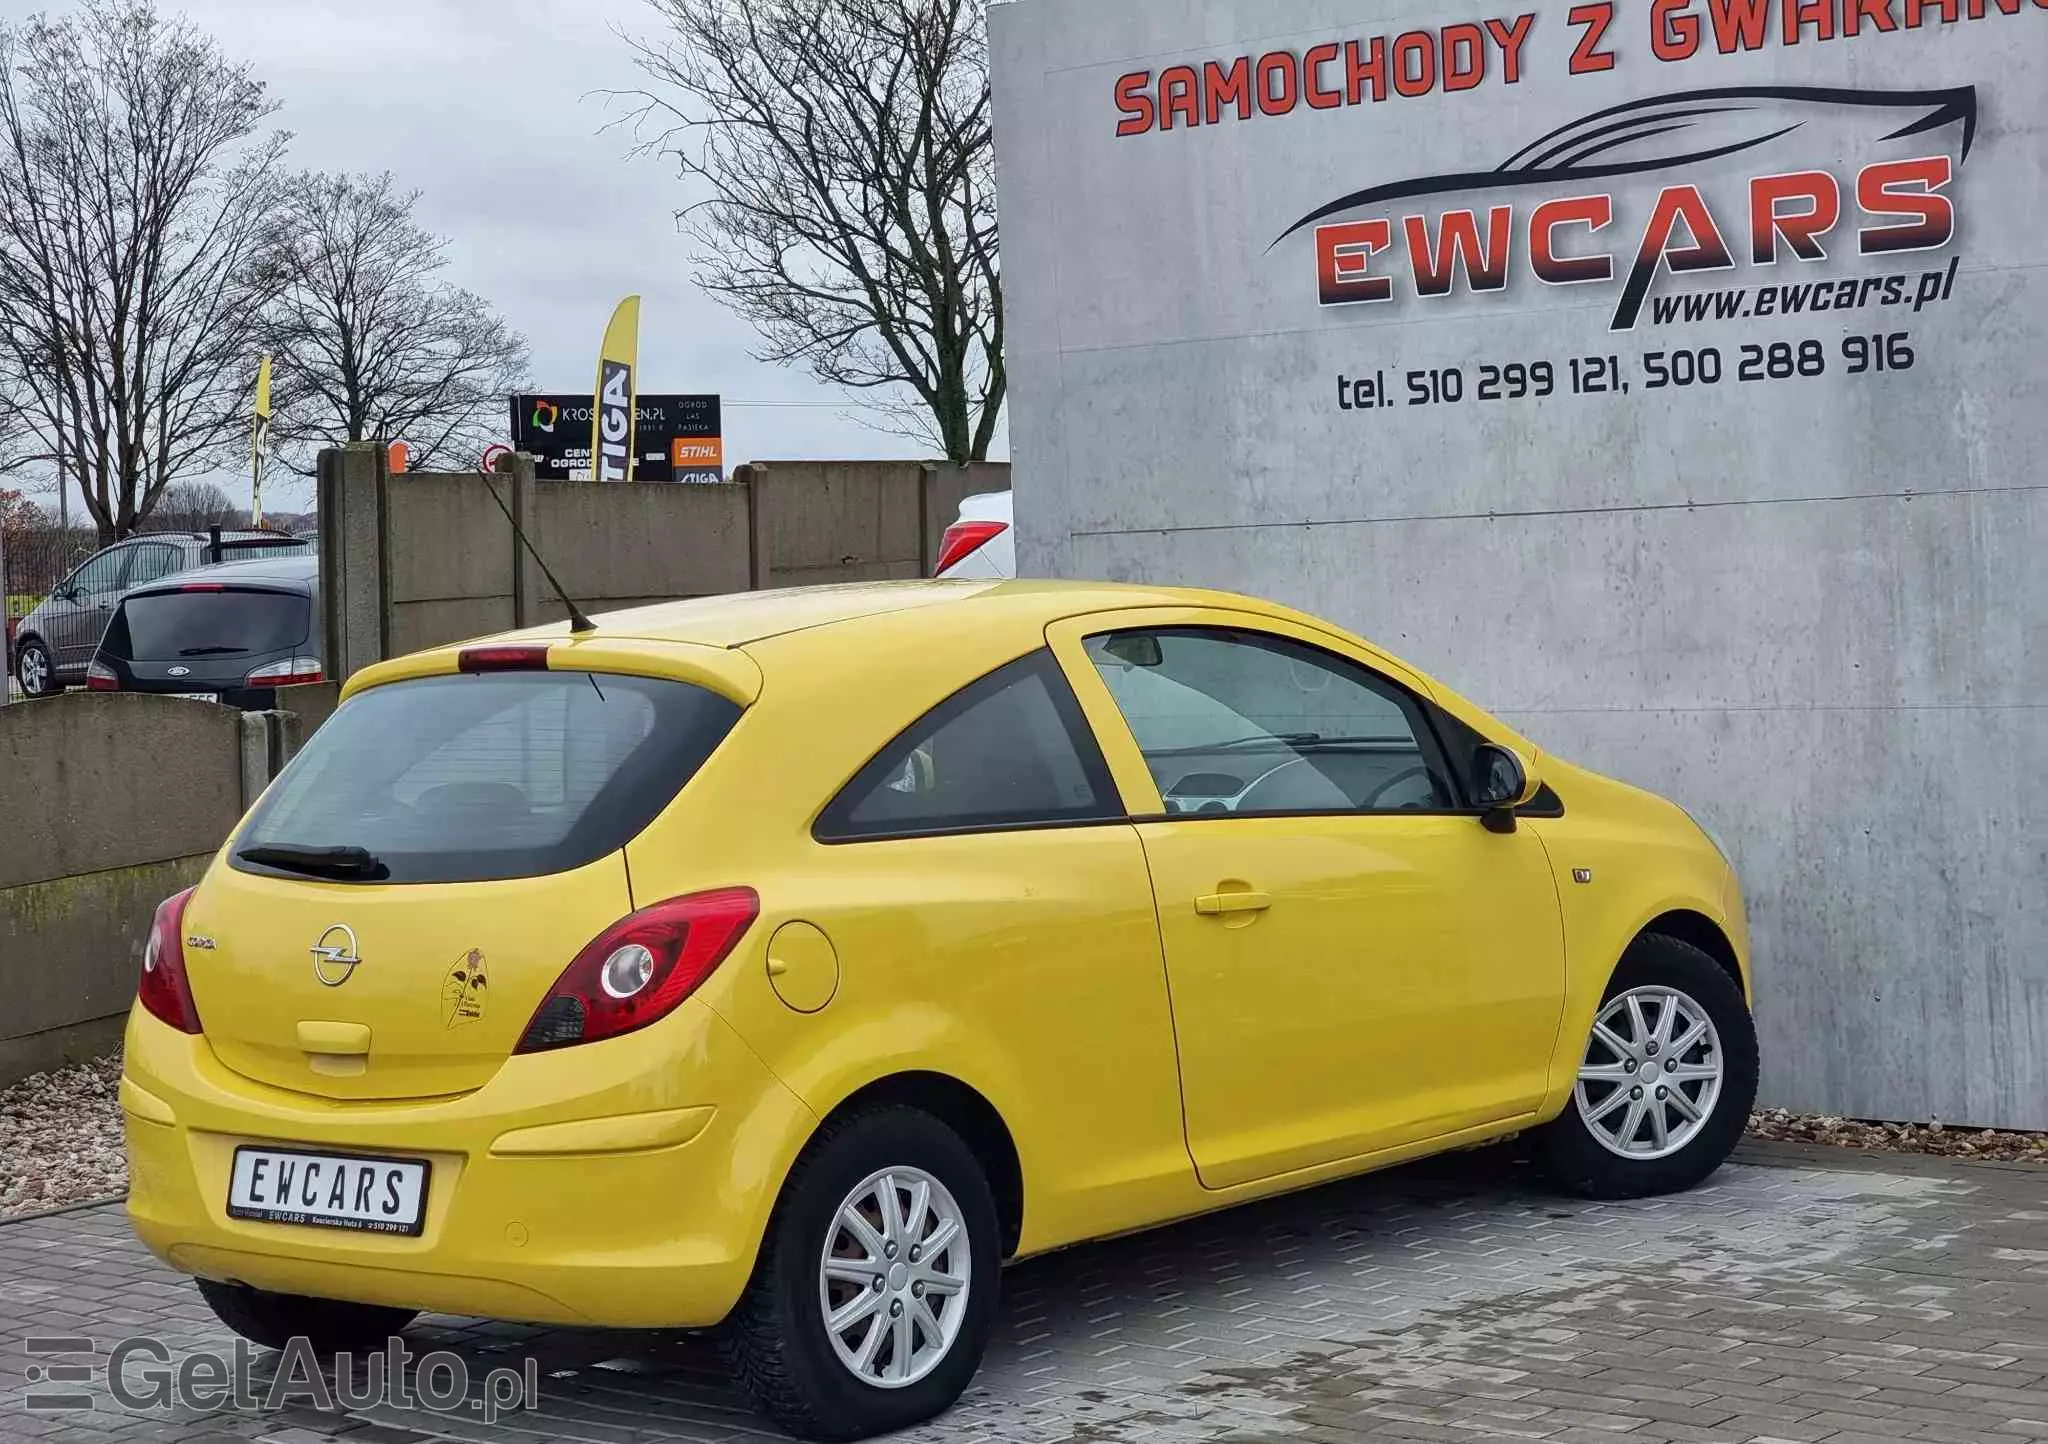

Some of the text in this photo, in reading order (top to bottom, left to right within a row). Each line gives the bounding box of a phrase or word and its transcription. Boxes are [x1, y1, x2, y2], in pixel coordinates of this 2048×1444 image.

[1114, 13, 1536, 138] SAMOCHODY
[1568, 2, 1616, 76] Z
[1314, 155, 1955, 333] EWCARS
[1651, 256, 1960, 328] www.ewcars.pl
[1337, 330, 1916, 411] tel. 510 299 121, 500 288 916
[679, 446, 717, 458] STIHL
[248, 1158, 404, 1215] EWCARS
[268, 1210, 306, 1224] EWCARS
